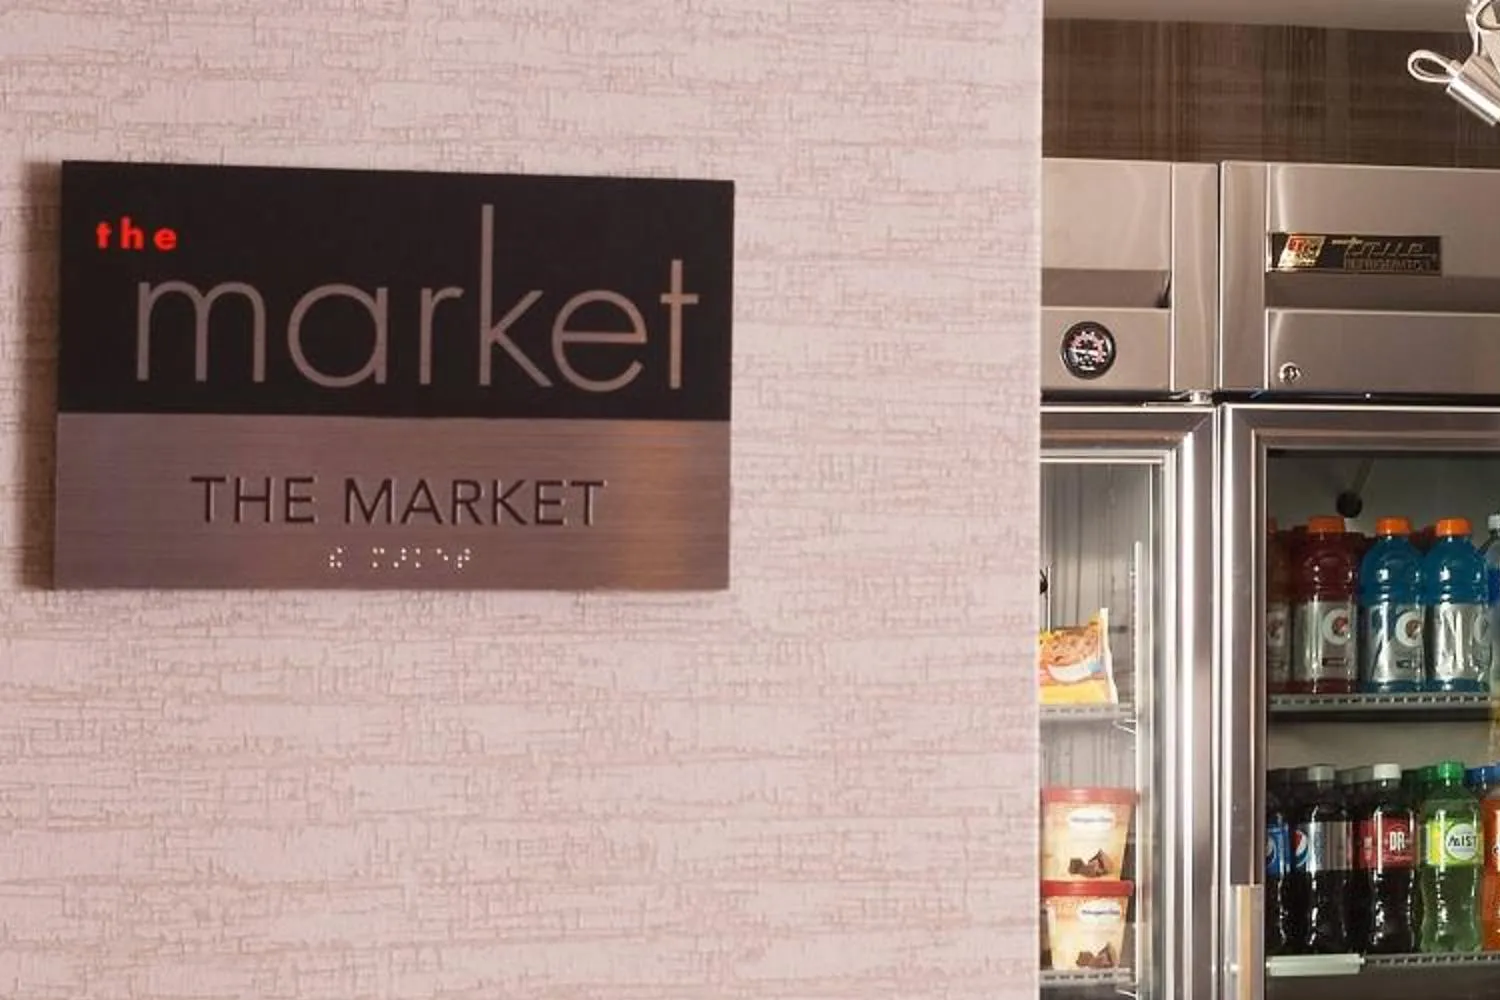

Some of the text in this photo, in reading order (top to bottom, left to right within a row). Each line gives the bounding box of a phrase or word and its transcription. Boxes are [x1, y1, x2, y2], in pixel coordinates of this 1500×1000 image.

[97, 217, 178, 251] the
[135, 203, 699, 391] market
[191, 475, 606, 526] THE MARKET
